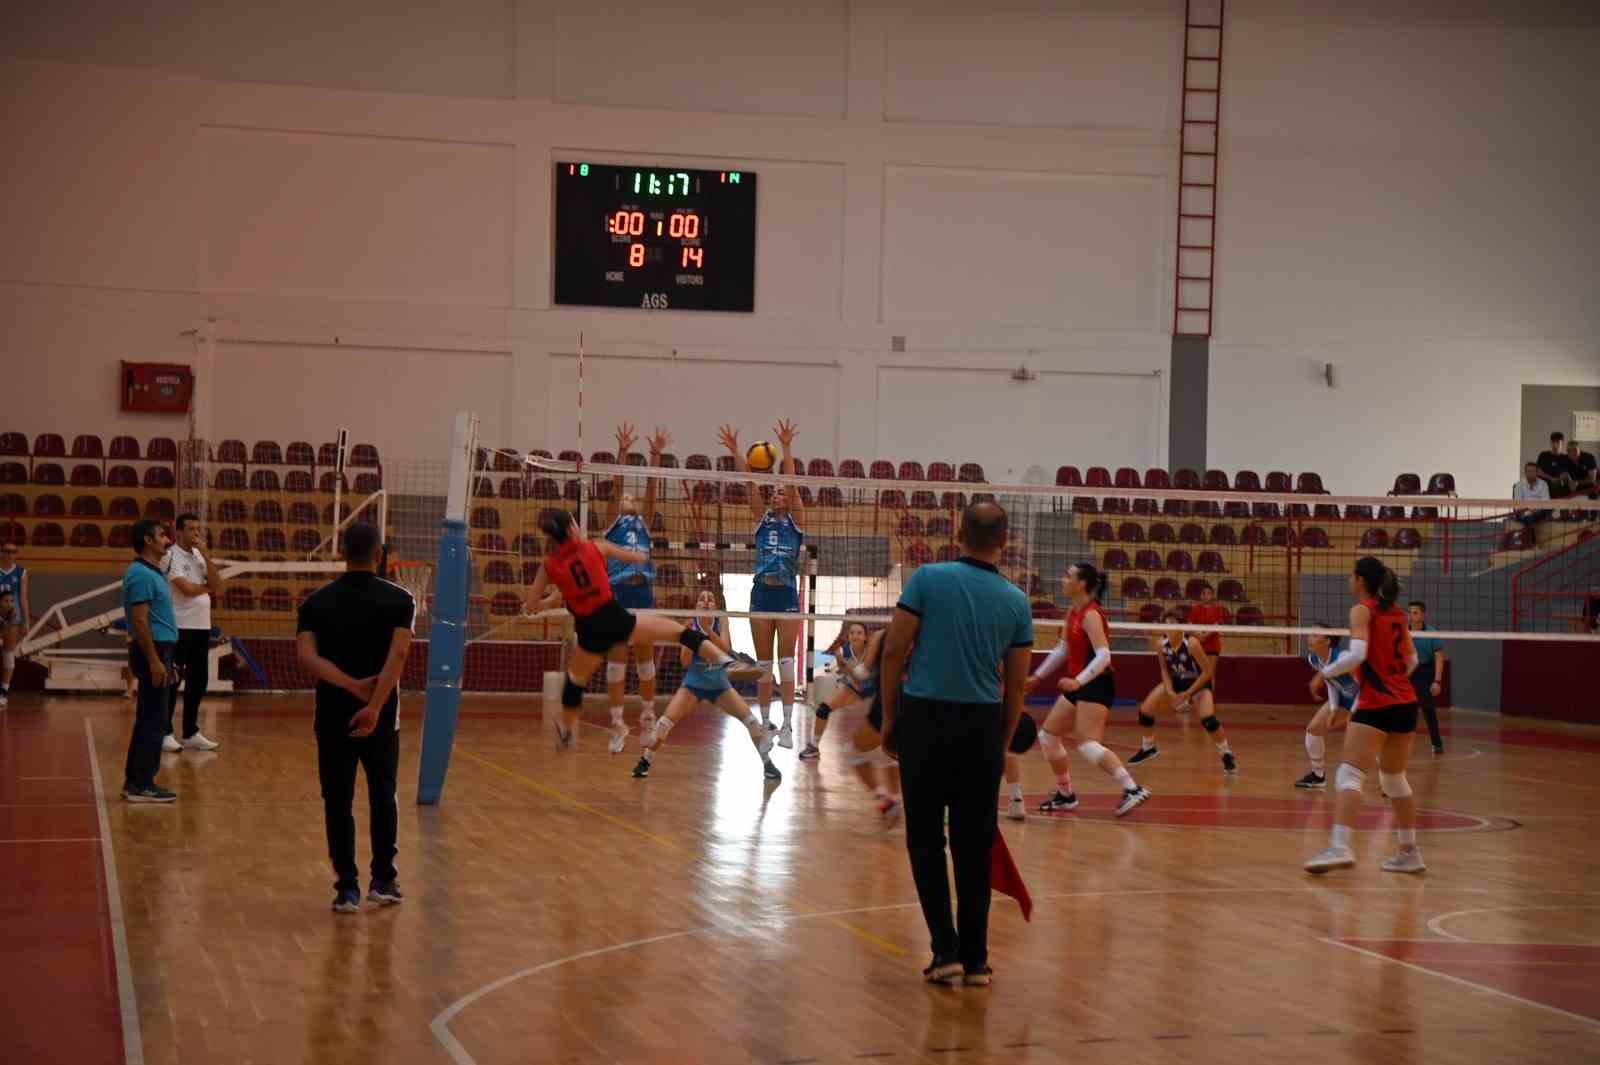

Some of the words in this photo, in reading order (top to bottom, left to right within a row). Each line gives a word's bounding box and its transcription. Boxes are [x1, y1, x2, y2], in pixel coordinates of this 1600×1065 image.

[580, 164, 589, 176] 8
[670, 214, 699, 238] 00
[629, 243, 645, 267] 8
[682, 247, 703, 268] 14
[642, 293, 668, 309] AGS
